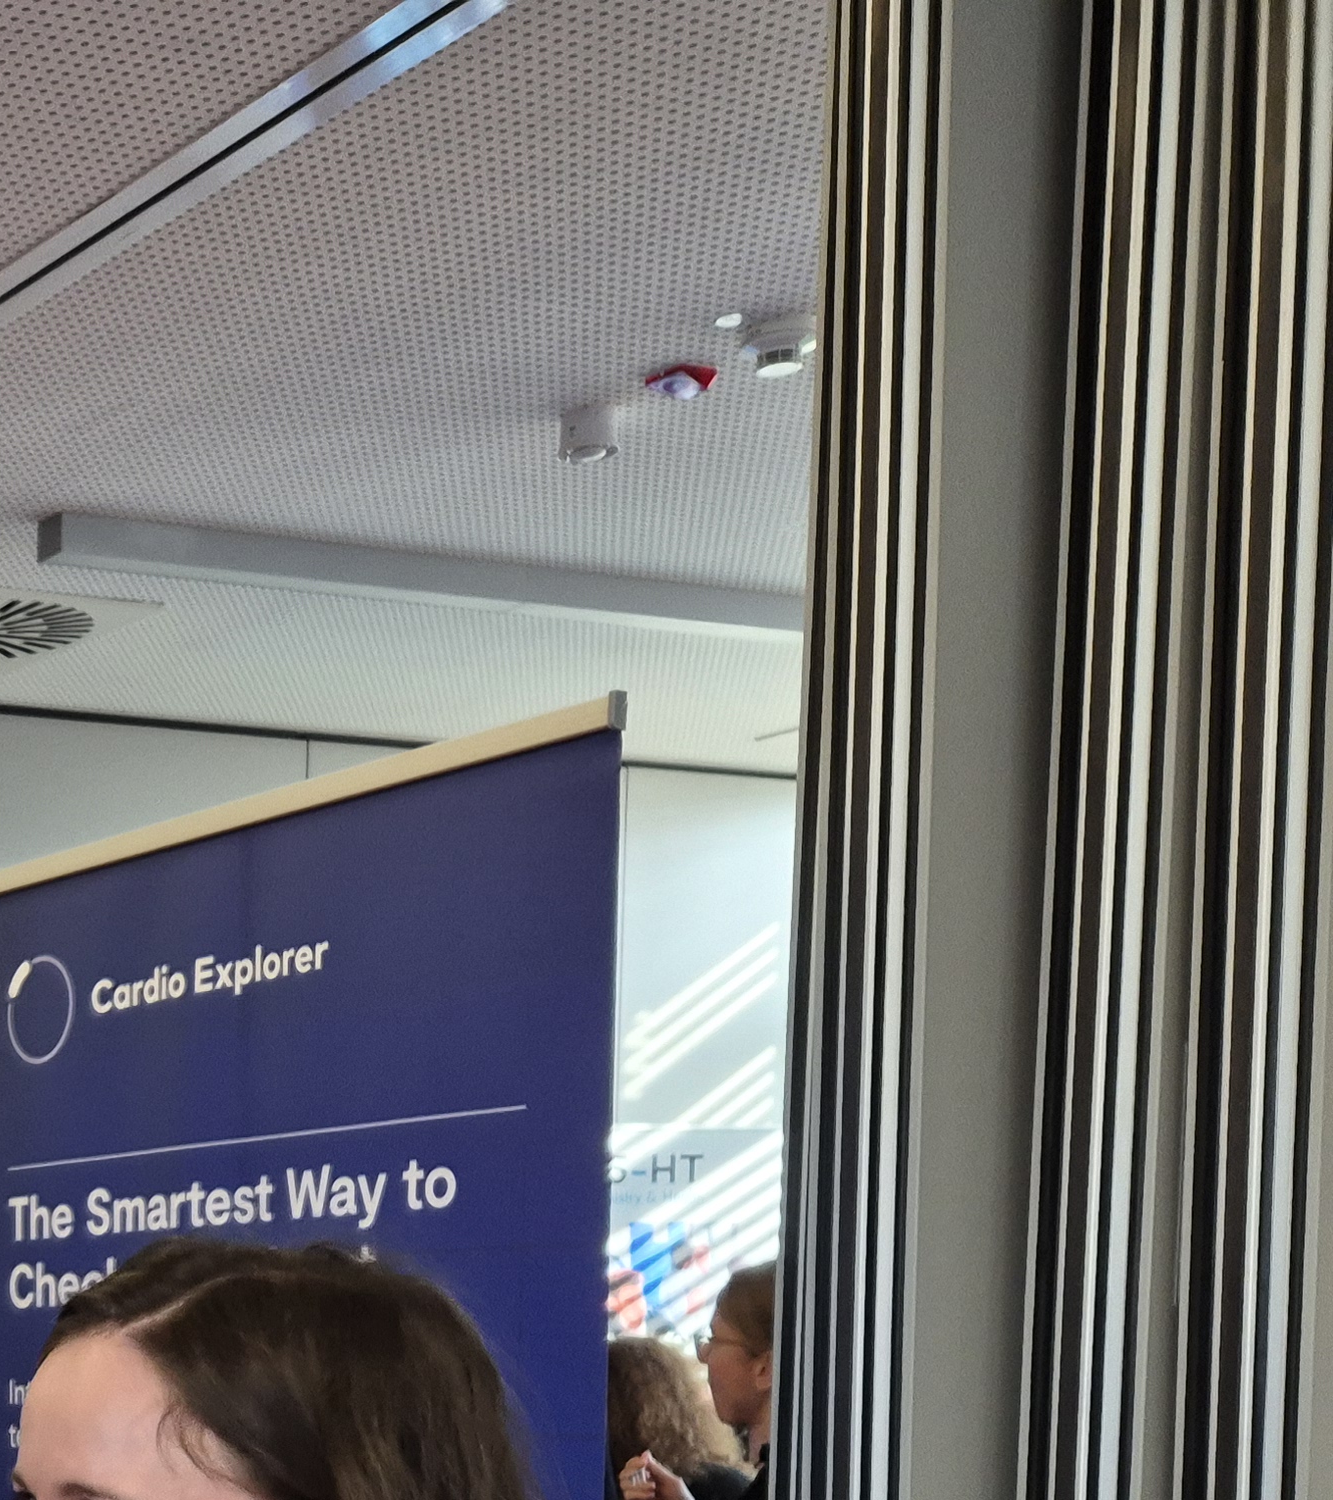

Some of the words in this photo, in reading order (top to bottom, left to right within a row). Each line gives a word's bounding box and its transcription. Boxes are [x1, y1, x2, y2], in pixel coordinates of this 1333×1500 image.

[91, 963, 186, 1014] Cardio
[193, 940, 330, 996] Explorer
[8, 1195, 74, 1241] The
[85, 1174, 274, 1236] Smartest
[286, 1163, 387, 1229] Way
[402, 1158, 457, 1210] to
[8, 1256, 118, 1310] Che
